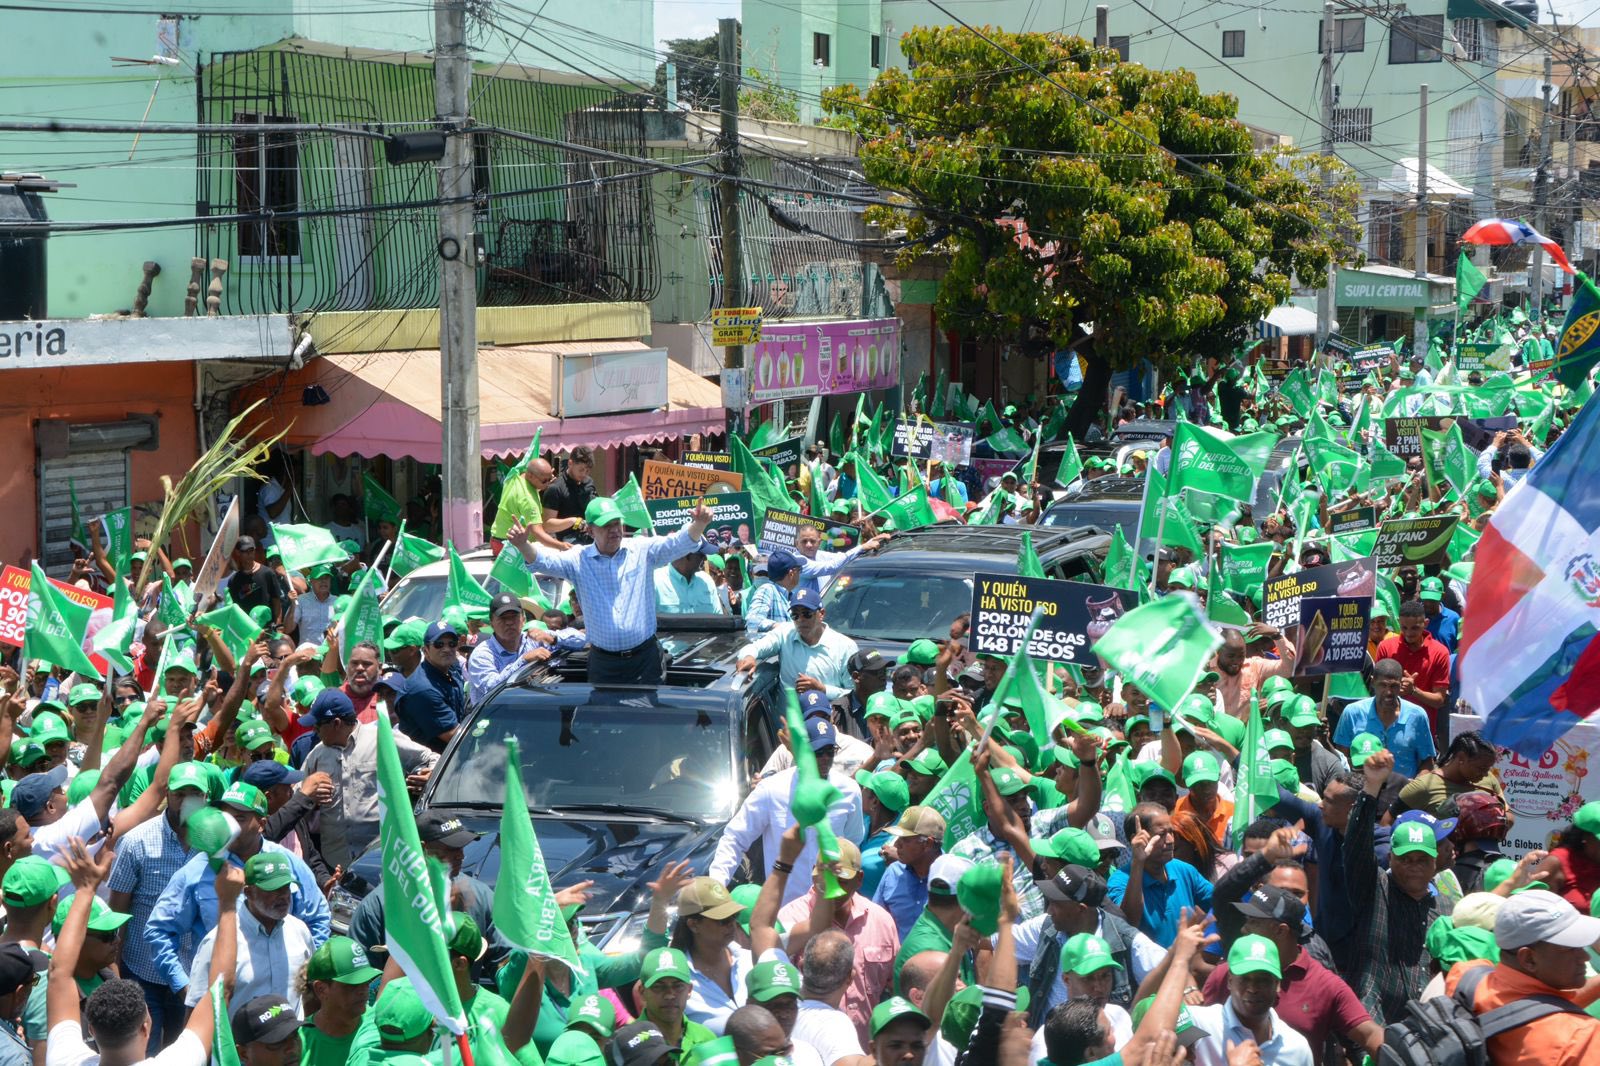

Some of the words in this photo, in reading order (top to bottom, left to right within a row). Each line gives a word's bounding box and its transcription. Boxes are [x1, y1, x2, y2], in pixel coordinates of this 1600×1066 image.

[1344, 285, 1375, 297] SUPLI
[1376, 284, 1423, 297] CENTRAL
[0, 322, 68, 358] eria
[1401, 445, 1409, 453] 15
[690, 452, 705, 461] QUIÉN
[1203, 452, 1236, 463] FUERZA
[655, 466, 674, 474] QUIÉN
[687, 471, 705, 480] VISTO
[707, 473, 720, 481] ESO
[1198, 462, 1215, 471] DEL
[1217, 464, 1252, 476] PUEBLO
[646, 485, 669, 496] SIN
[647, 475, 662, 486] LA
[666, 478, 707, 492] CALLE
[651, 516, 692, 527] DERECHO
[712, 512, 748, 521] RABAJO
[772, 512, 789, 523] QUIÉN
[765, 521, 796, 535] MEDICINA
[1414, 521, 1429, 530] VISTO
[1430, 520, 1441, 528] ESO
[764, 531, 775, 541] TAN
[776, 533, 795, 546] CARA
[1377, 530, 1427, 544] PLÁTANO
[1372, 547, 1382, 555] A
[1384, 544, 1397, 554] 30
[1377, 554, 1403, 565] ESOS
[7, 573, 15, 584] Y
[1268, 584, 1273, 592] Y
[1274, 576, 1296, 591] QUIÉN
[982, 581, 990, 594] Y
[992, 581, 1026, 598] QUIÉN
[1268, 592, 1277, 602] HA
[1279, 585, 1300, 598] VISTO
[1302, 582, 1317, 593] ESO
[981, 596, 997, 610] HA
[1000, 598, 1032, 613] VISTO
[1266, 599, 1286, 612] POR
[1288, 595, 1302, 604] UN
[1339, 604, 1342, 614] Y
[1343, 600, 1358, 616] QUIÉN
[6, 607, 27, 624] 90
[1266, 604, 1299, 619] GALÓN
[979, 611, 1010, 625] POR
[1014, 615, 1034, 627] UN
[1331, 619, 1339, 630] HA
[1339, 618, 1353, 629] VISTO
[1354, 617, 1363, 628] ESO
[46, 624, 65, 638] DEL
[977, 623, 1028, 639] GALÓN
[1032, 629, 1053, 641] DE
[1056, 632, 1085, 646] GAS
[1331, 632, 1361, 646] SOPITAS
[976, 636, 1008, 652] 148
[1012, 639, 1075, 660] PESOS
[1325, 649, 1331, 661] A
[1332, 648, 1340, 660] 10
[1341, 647, 1363, 660] PESOS
[1503, 768, 1529, 778] Estrella
[1532, 770, 1563, 781] Balloons
[1502, 839, 1512, 847] De
[1515, 839, 1543, 849] Globos
[388, 858, 408, 898] DEL
[259, 1011, 273, 1022] RD
